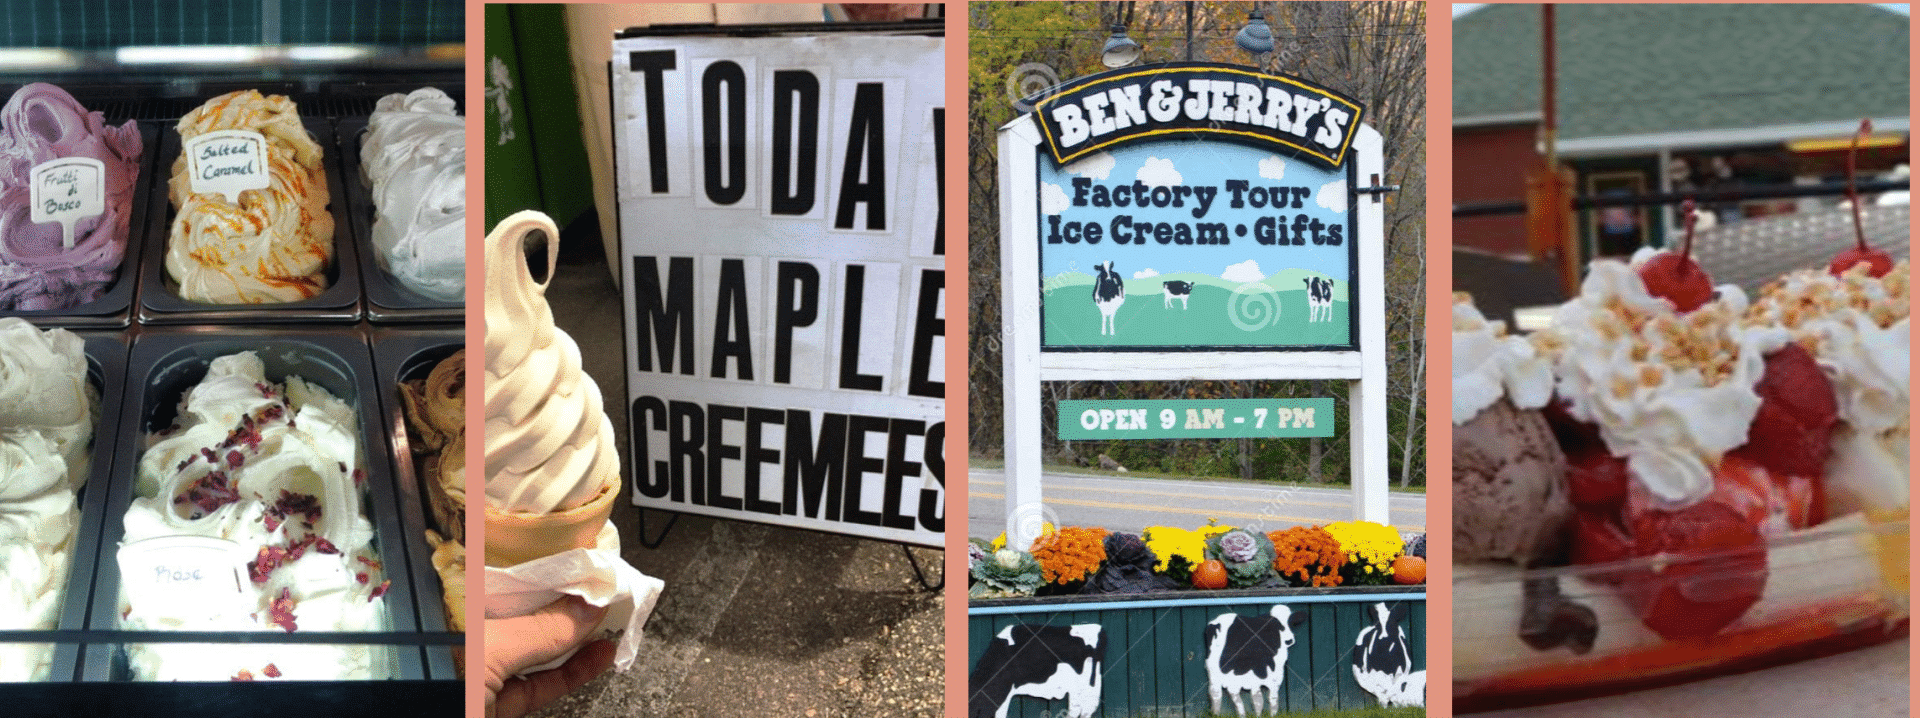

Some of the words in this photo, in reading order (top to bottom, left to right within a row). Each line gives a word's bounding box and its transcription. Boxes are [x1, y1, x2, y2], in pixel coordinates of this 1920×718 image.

[201, 142, 249, 160] Salted
[629, 48, 945, 256] TODA
[202, 160, 254, 180] Caramel
[44, 198, 81, 215] Bosco
[1072, 177, 1218, 218] Factory
[1226, 179, 1311, 208] Tour
[1047, 214, 1103, 245] Ice
[1110, 214, 1231, 245] Cream
[1254, 213, 1344, 246] Gifts
[632, 255, 945, 399] MAPLE
[1080, 408, 1148, 430] OPEN
[1159, 407, 1177, 430] 9
[1184, 407, 1225, 430] AM
[1253, 407, 1269, 429] 7
[1278, 406, 1316, 429] PM
[631, 395, 945, 534] CREEMEES
